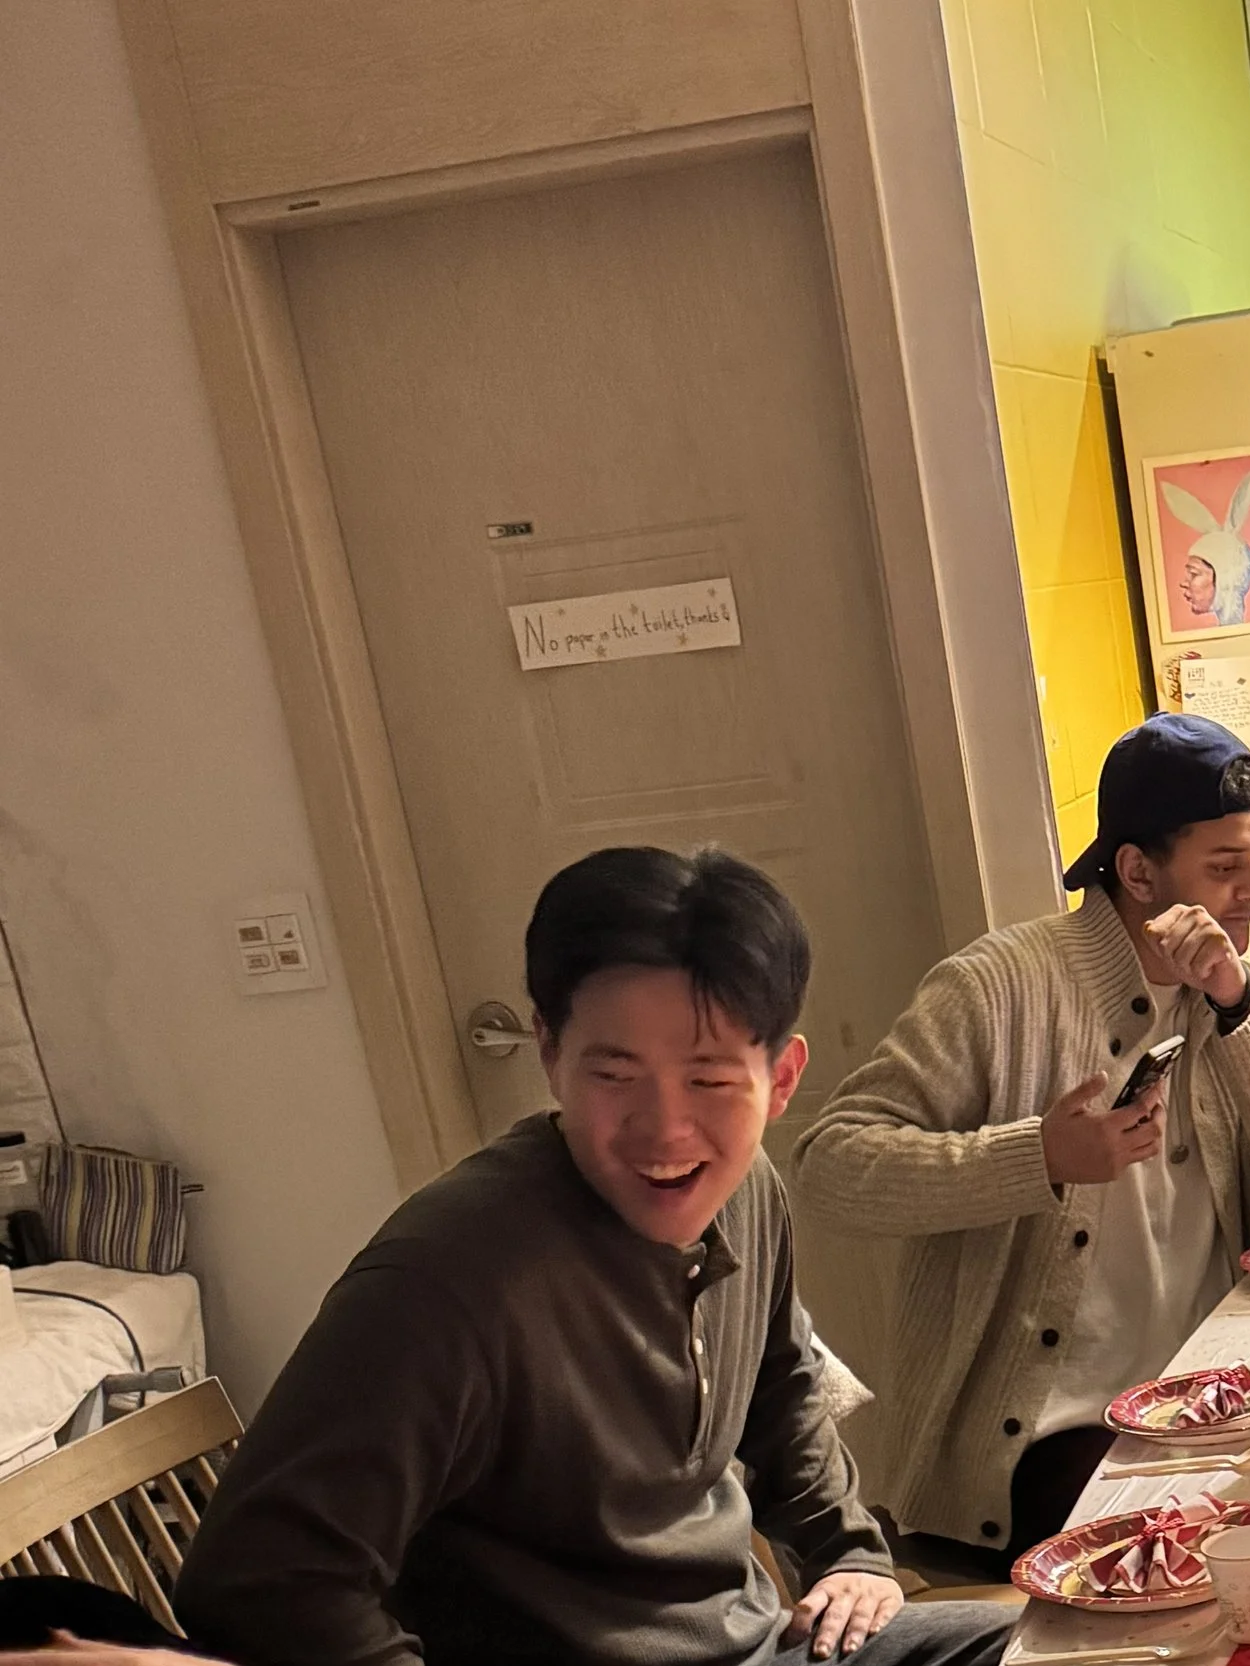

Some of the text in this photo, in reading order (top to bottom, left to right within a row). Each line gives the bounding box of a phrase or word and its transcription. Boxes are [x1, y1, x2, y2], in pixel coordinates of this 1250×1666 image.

[524, 614, 558, 657] No
[565, 633, 594, 653] paper
[612, 613, 639, 639] the
[683, 604, 720, 627] thanks
